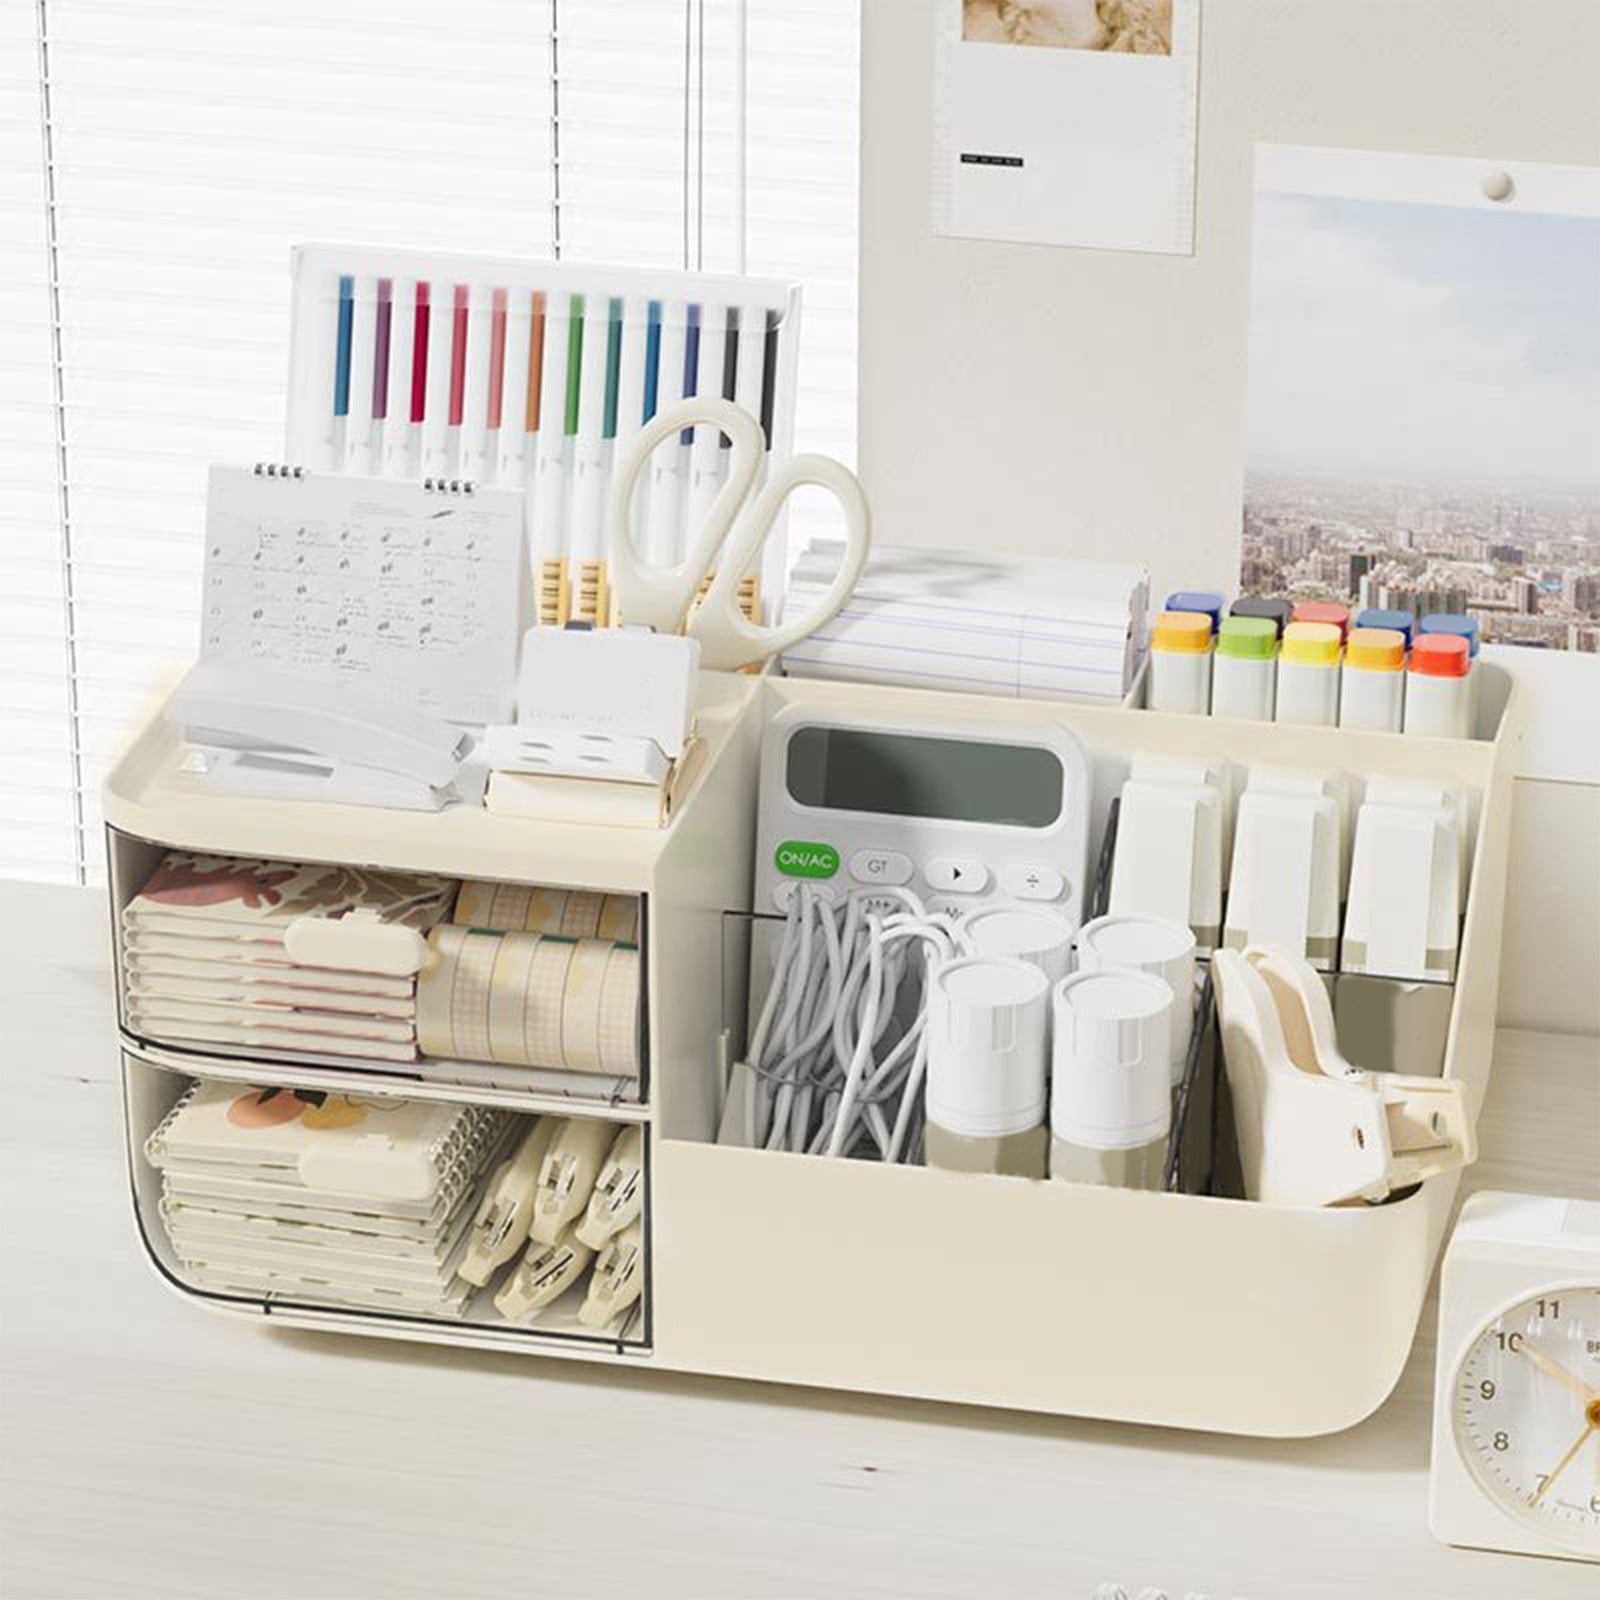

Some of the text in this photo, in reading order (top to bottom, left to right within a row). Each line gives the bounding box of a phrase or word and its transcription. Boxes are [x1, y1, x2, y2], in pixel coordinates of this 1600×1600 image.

[778, 849, 833, 870] ON/AC
[867, 859, 888, 874] GT
[1537, 1300, 1560, 1319] 11
[1496, 1332, 1523, 1352] 10
[1480, 1380, 1495, 1400] 9
[1493, 1433, 1509, 1451] 8
[1535, 1474, 1551, 1496] 7
